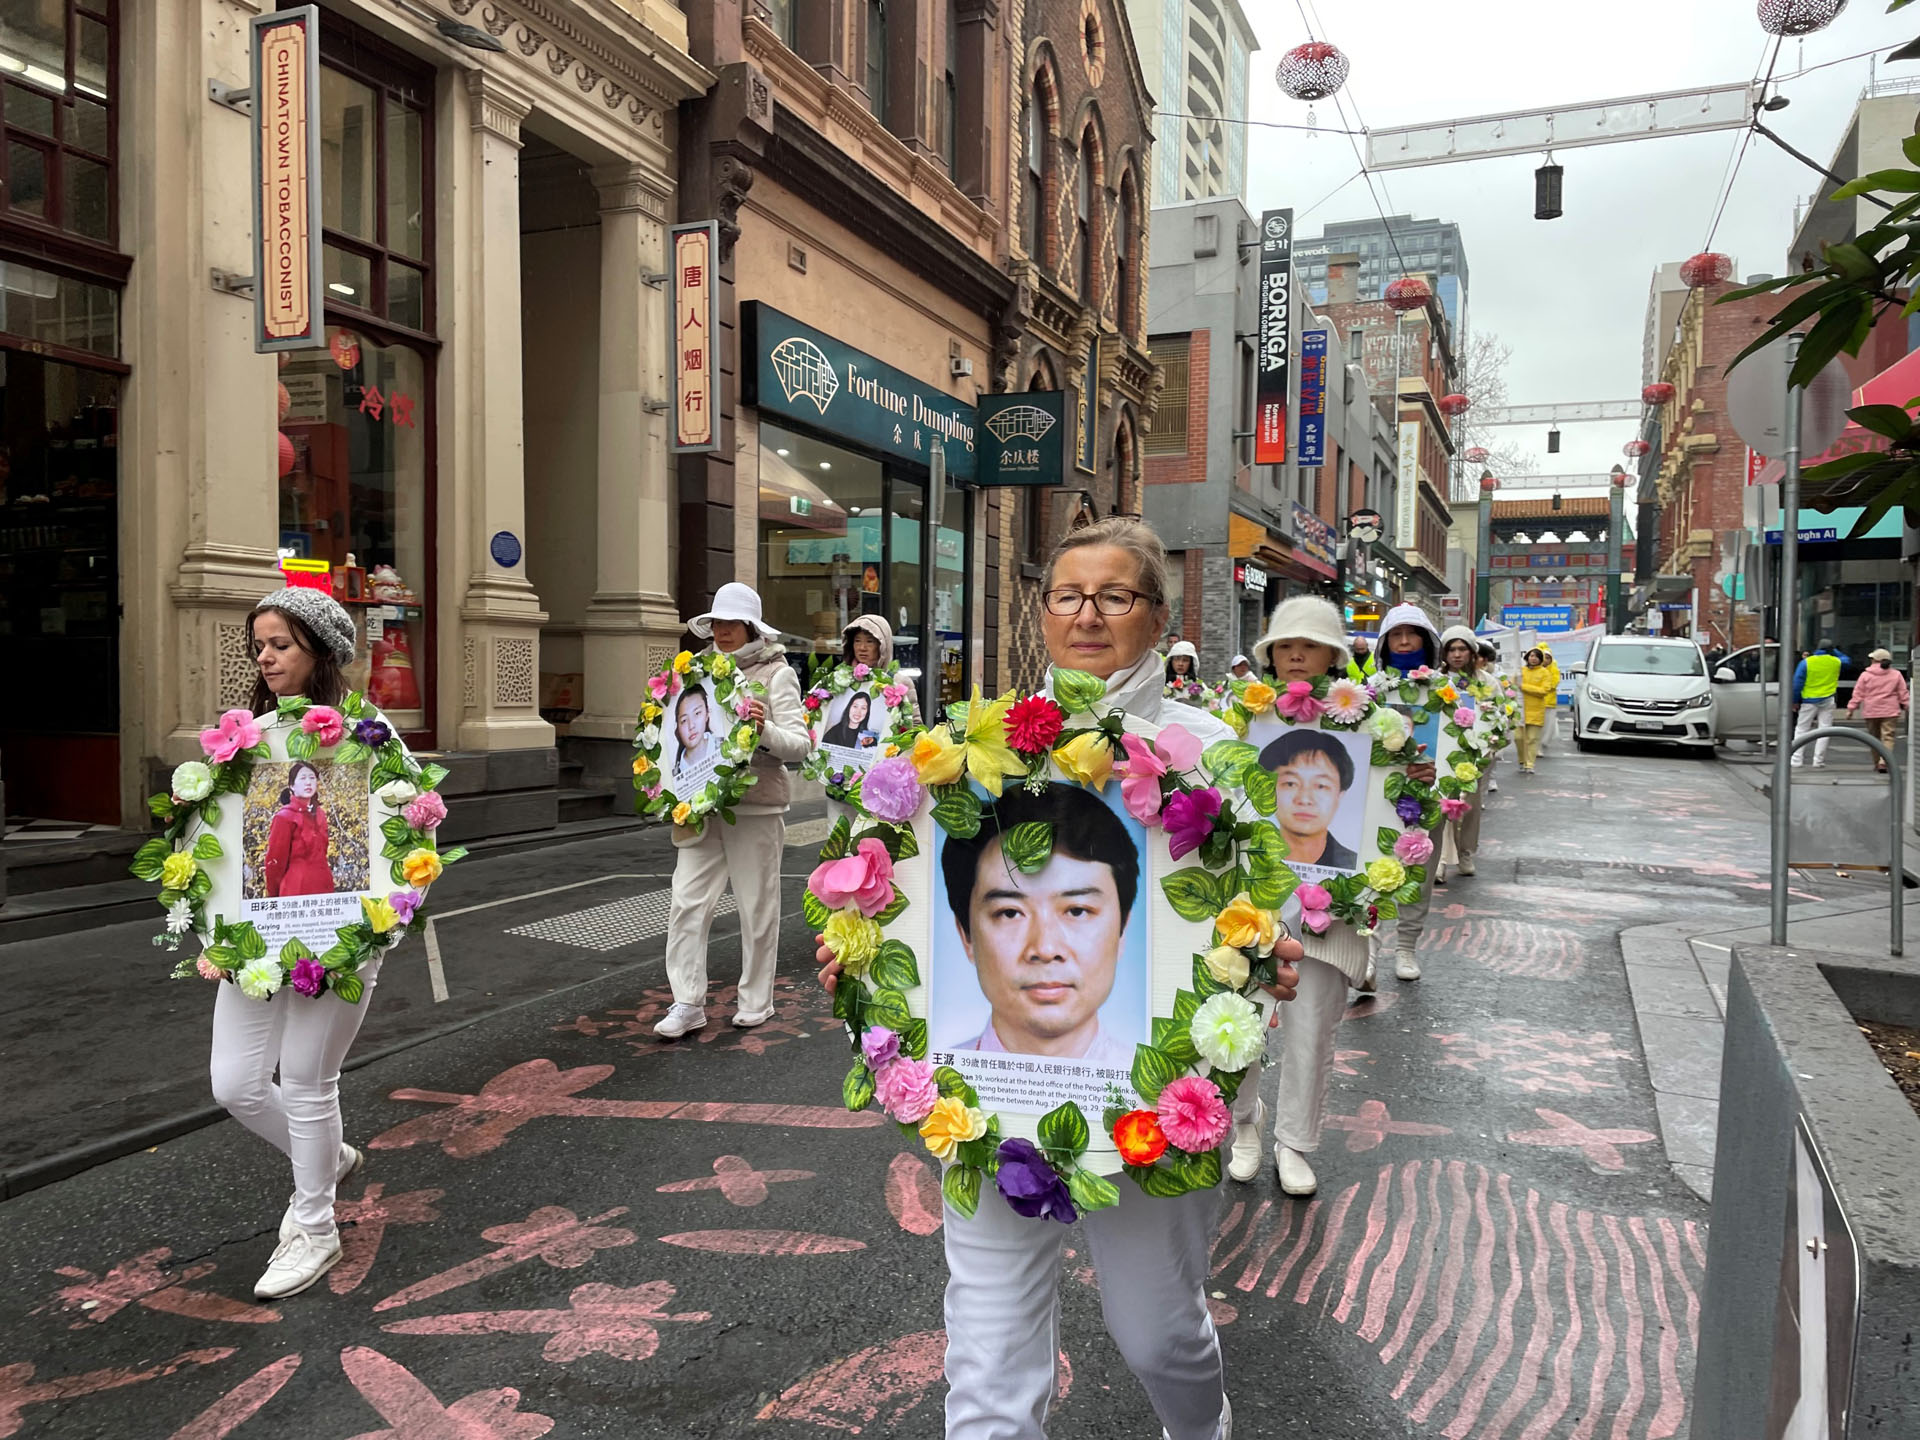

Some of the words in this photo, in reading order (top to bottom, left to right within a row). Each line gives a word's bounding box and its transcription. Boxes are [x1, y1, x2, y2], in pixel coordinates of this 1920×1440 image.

[277, 49, 291, 169] CHINATOWN
[278, 173, 293, 313] TOBACCONIST
[1266, 272, 1288, 372] BORNGA
[683, 265, 703, 413] 唐人烟行
[359, 385, 416, 429] 冷饮
[847, 362, 908, 418] Fortune
[912, 393, 975, 453] Dumpling
[1271, 403, 1279, 428] Korean
[1000, 449, 1040, 465] 余庆楼
[1823, 529, 1834, 538] Al
[1250, 567, 1267, 586] BORNGA
[251, 900, 279, 912] 田彩英
[257, 923, 281, 932] Caiying
[1016, 1077, 1028, 1085] the
[1028, 1079, 1045, 1087] head
[1046, 1080, 1064, 1088] office
[1064, 1081, 1072, 1089] of
[1073, 1082, 1084, 1090] the
[978, 1085, 996, 1093] being
[997, 1086, 1019, 1095] beaten
[1028, 1088, 1047, 1097] death
[1055, 1091, 1067, 1099] the
[1068, 1093, 1087, 1102] Jining
[1088, 1094, 1102, 1103] City
[977, 1095, 1005, 1103] ometime
[1006, 1096, 1034, 1105] between
[1035, 1099, 1049, 1108] Aug.
[1090, 1104, 1101, 1113] 29,
